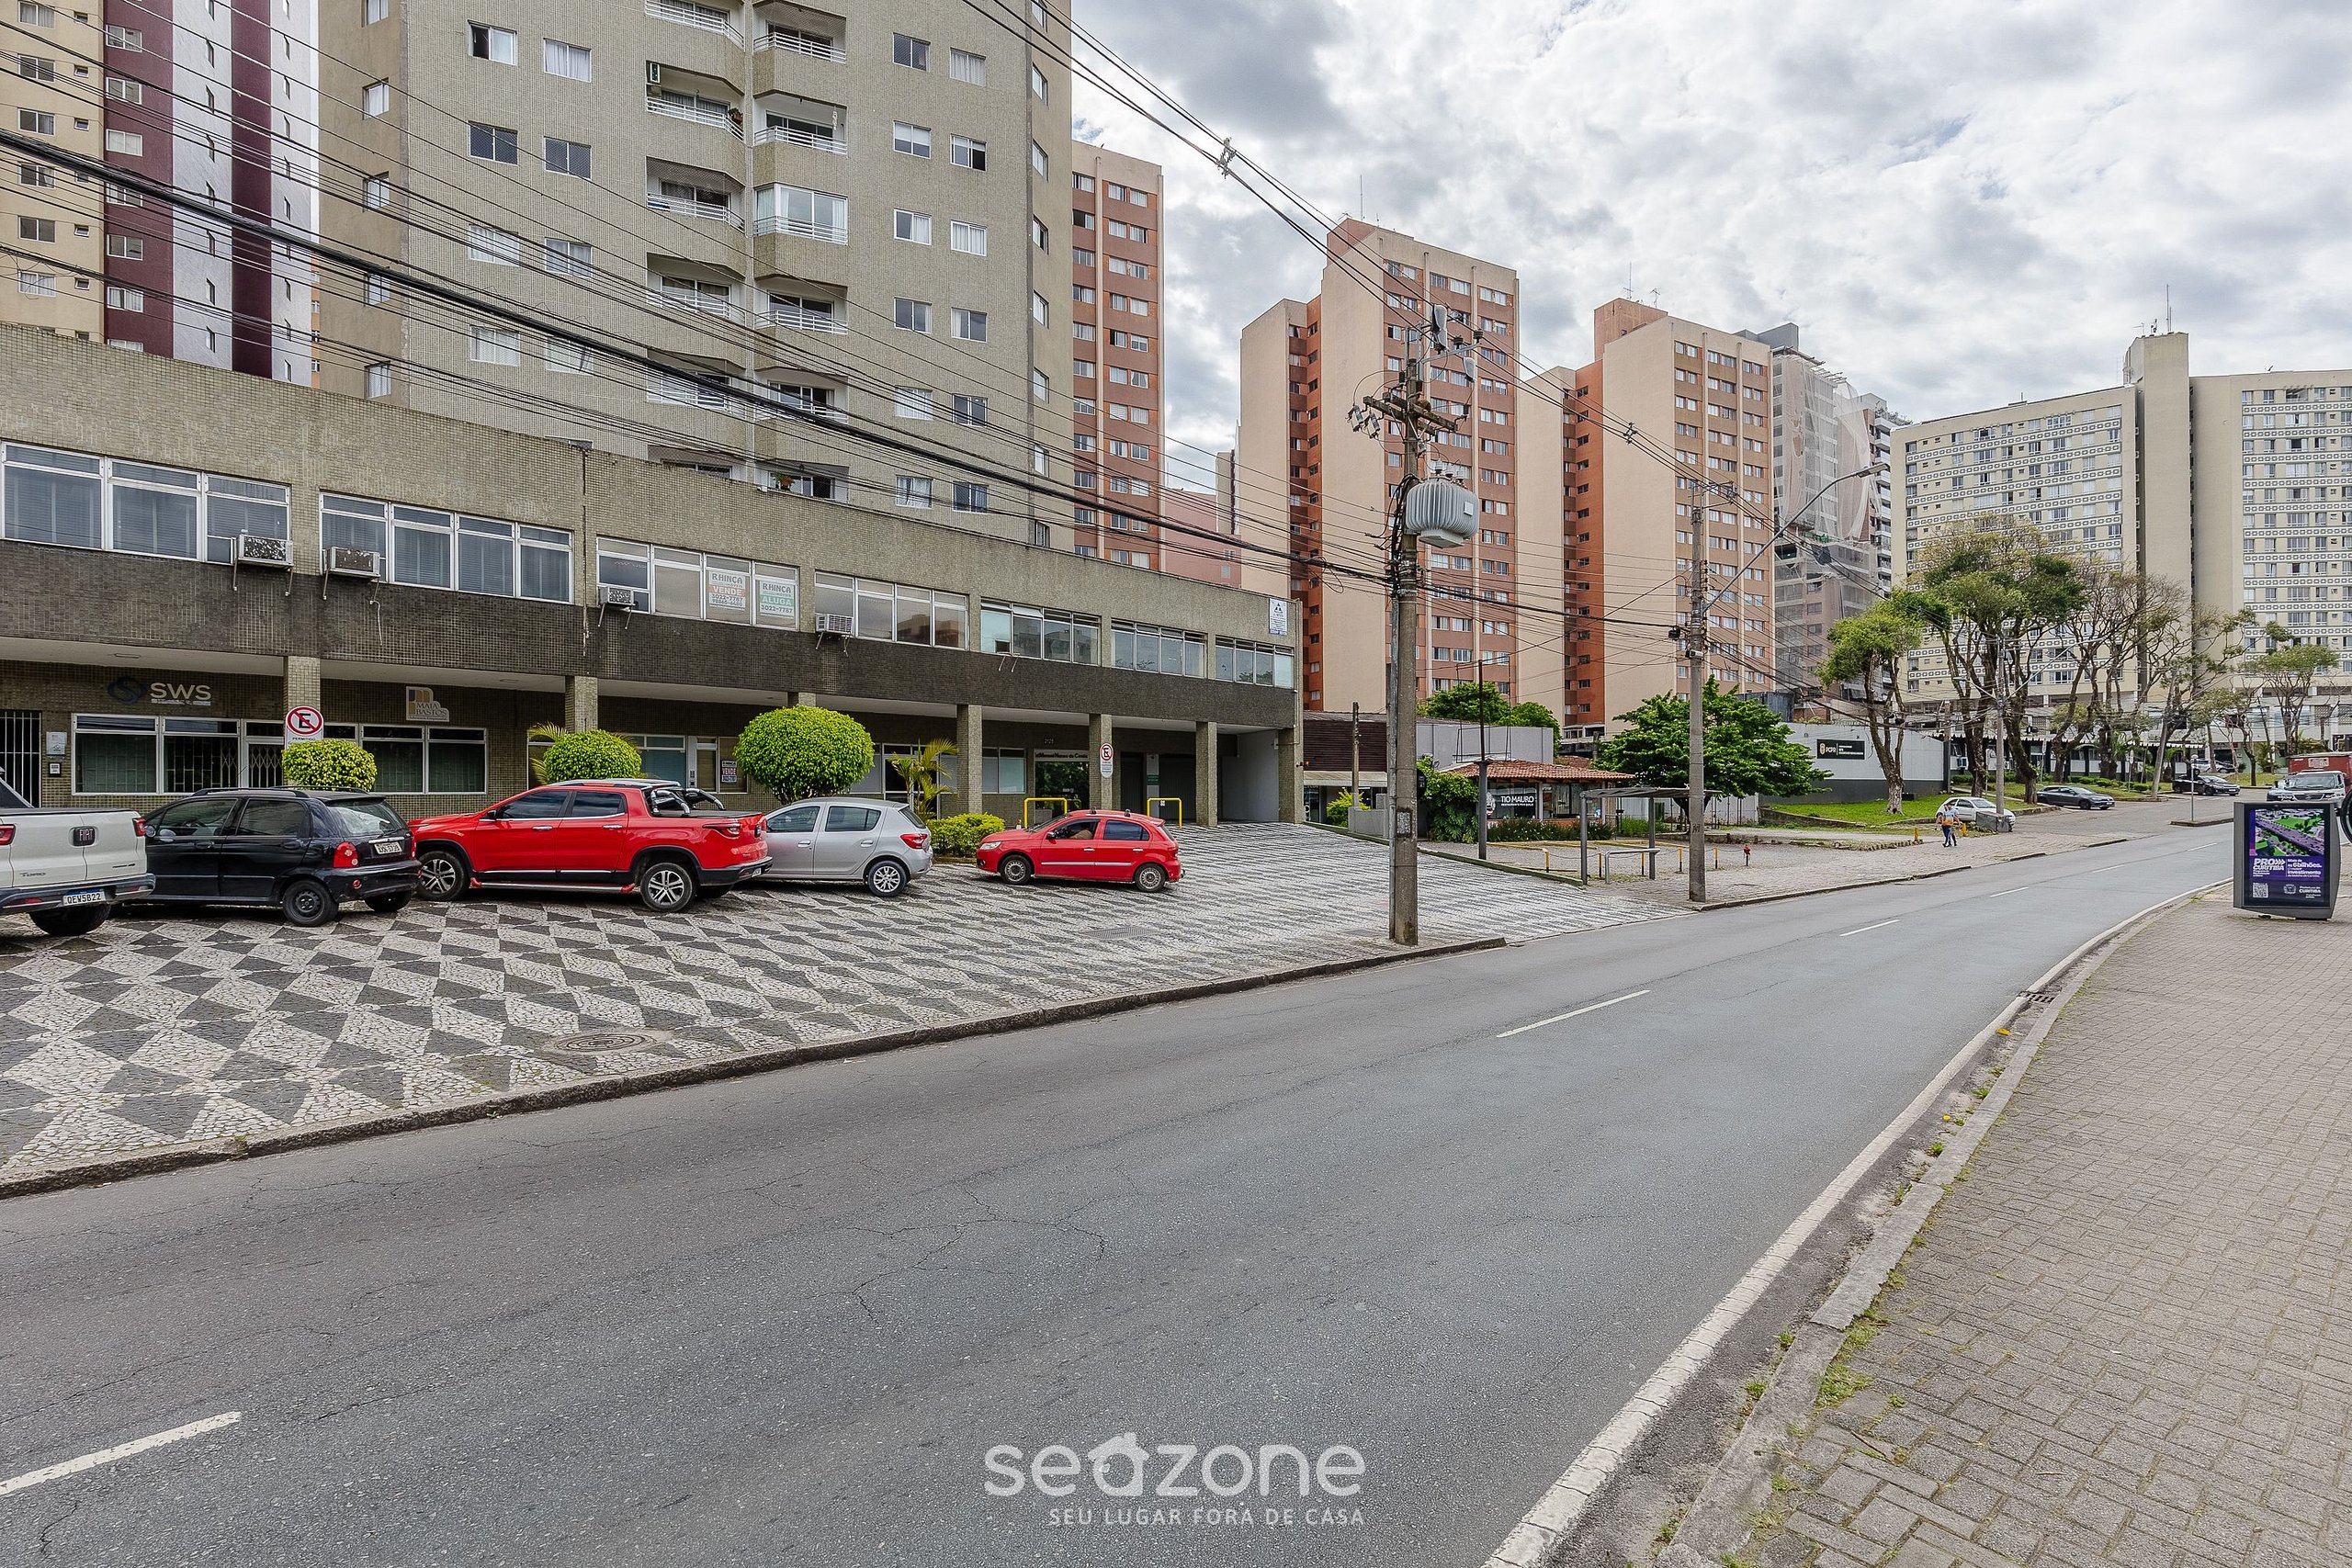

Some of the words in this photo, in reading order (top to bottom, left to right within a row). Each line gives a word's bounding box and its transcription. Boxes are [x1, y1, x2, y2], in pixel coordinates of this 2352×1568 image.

[712, 573, 742, 584] RHINCA
[713, 586, 741, 596] VENDE
[763, 583, 791, 593] RHINCA
[762, 596, 792, 606] ALUGA
[761, 604, 793, 613] 3022-7787
[150, 682, 211, 700] SWS
[299, 713, 311, 728] E
[79, 829, 93, 841] FIAT
